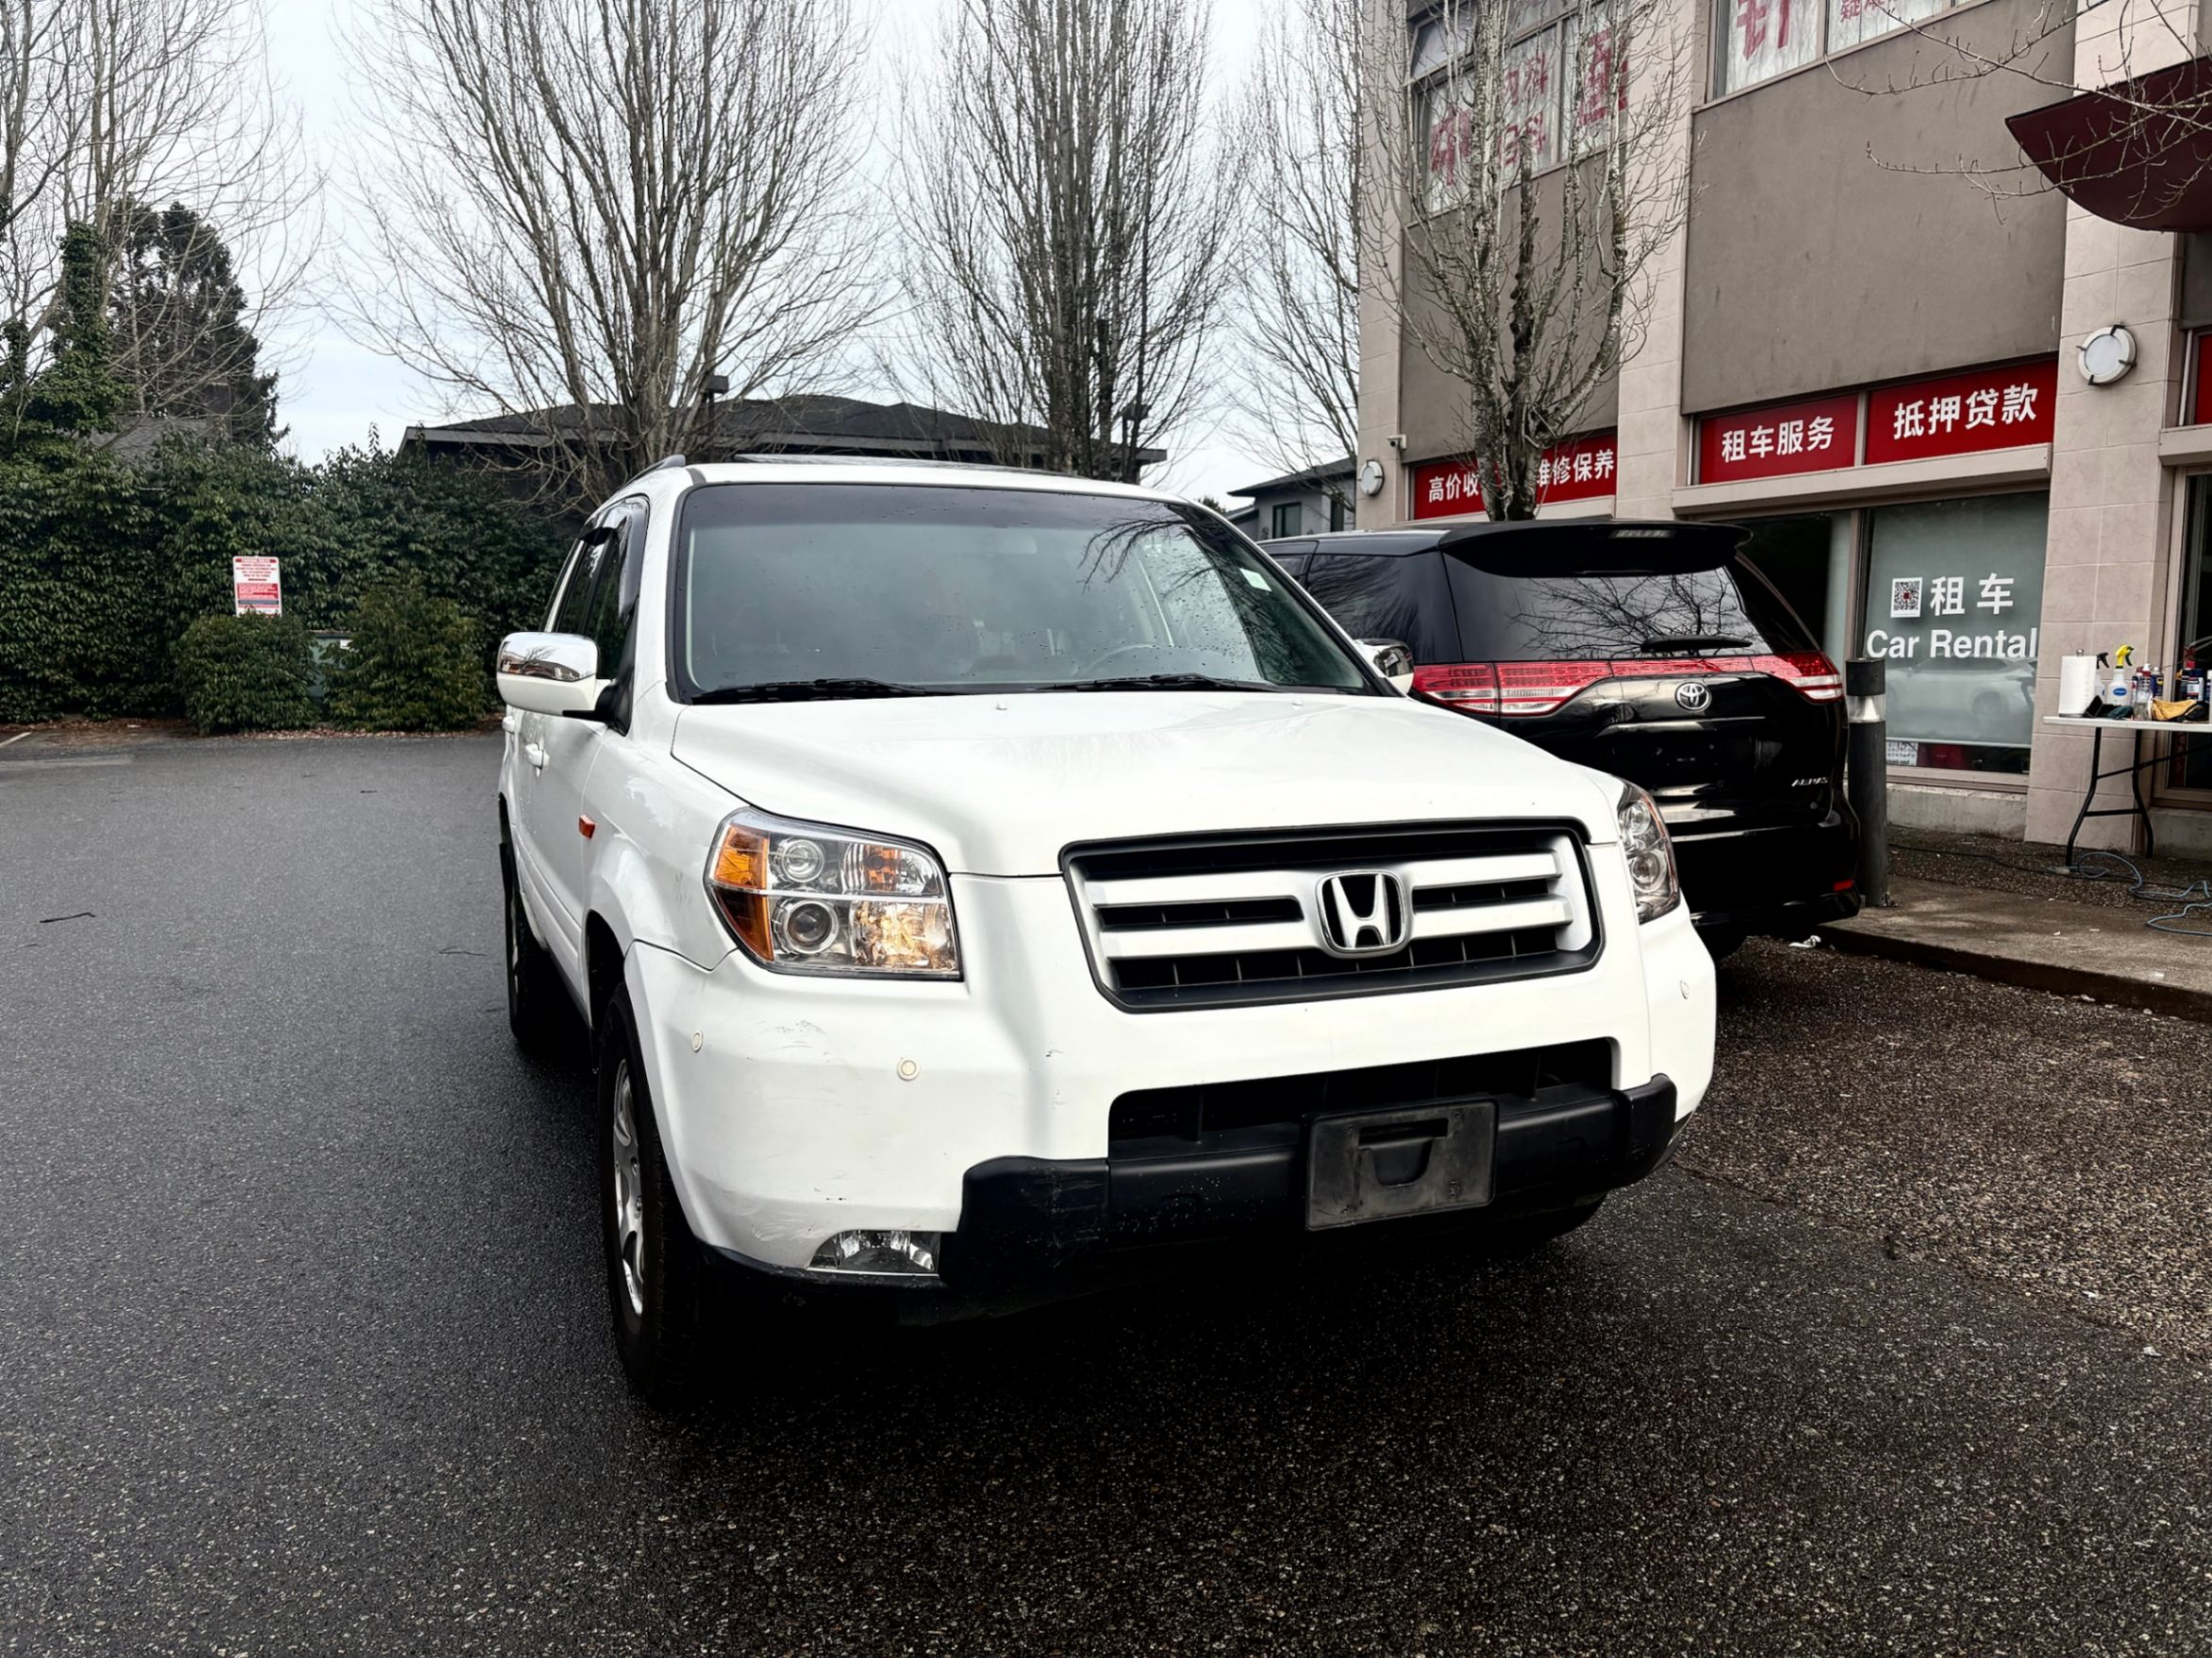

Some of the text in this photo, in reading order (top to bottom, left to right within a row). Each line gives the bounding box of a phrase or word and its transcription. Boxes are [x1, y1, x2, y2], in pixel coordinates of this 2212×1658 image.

[1893, 383, 2038, 440] 抵押贷款
[1721, 416, 1835, 463] 租车服务
[1429, 473, 1481, 503] 高价收
[1930, 572, 2015, 616] 租车
[1867, 627, 2038, 658] Car Rental
